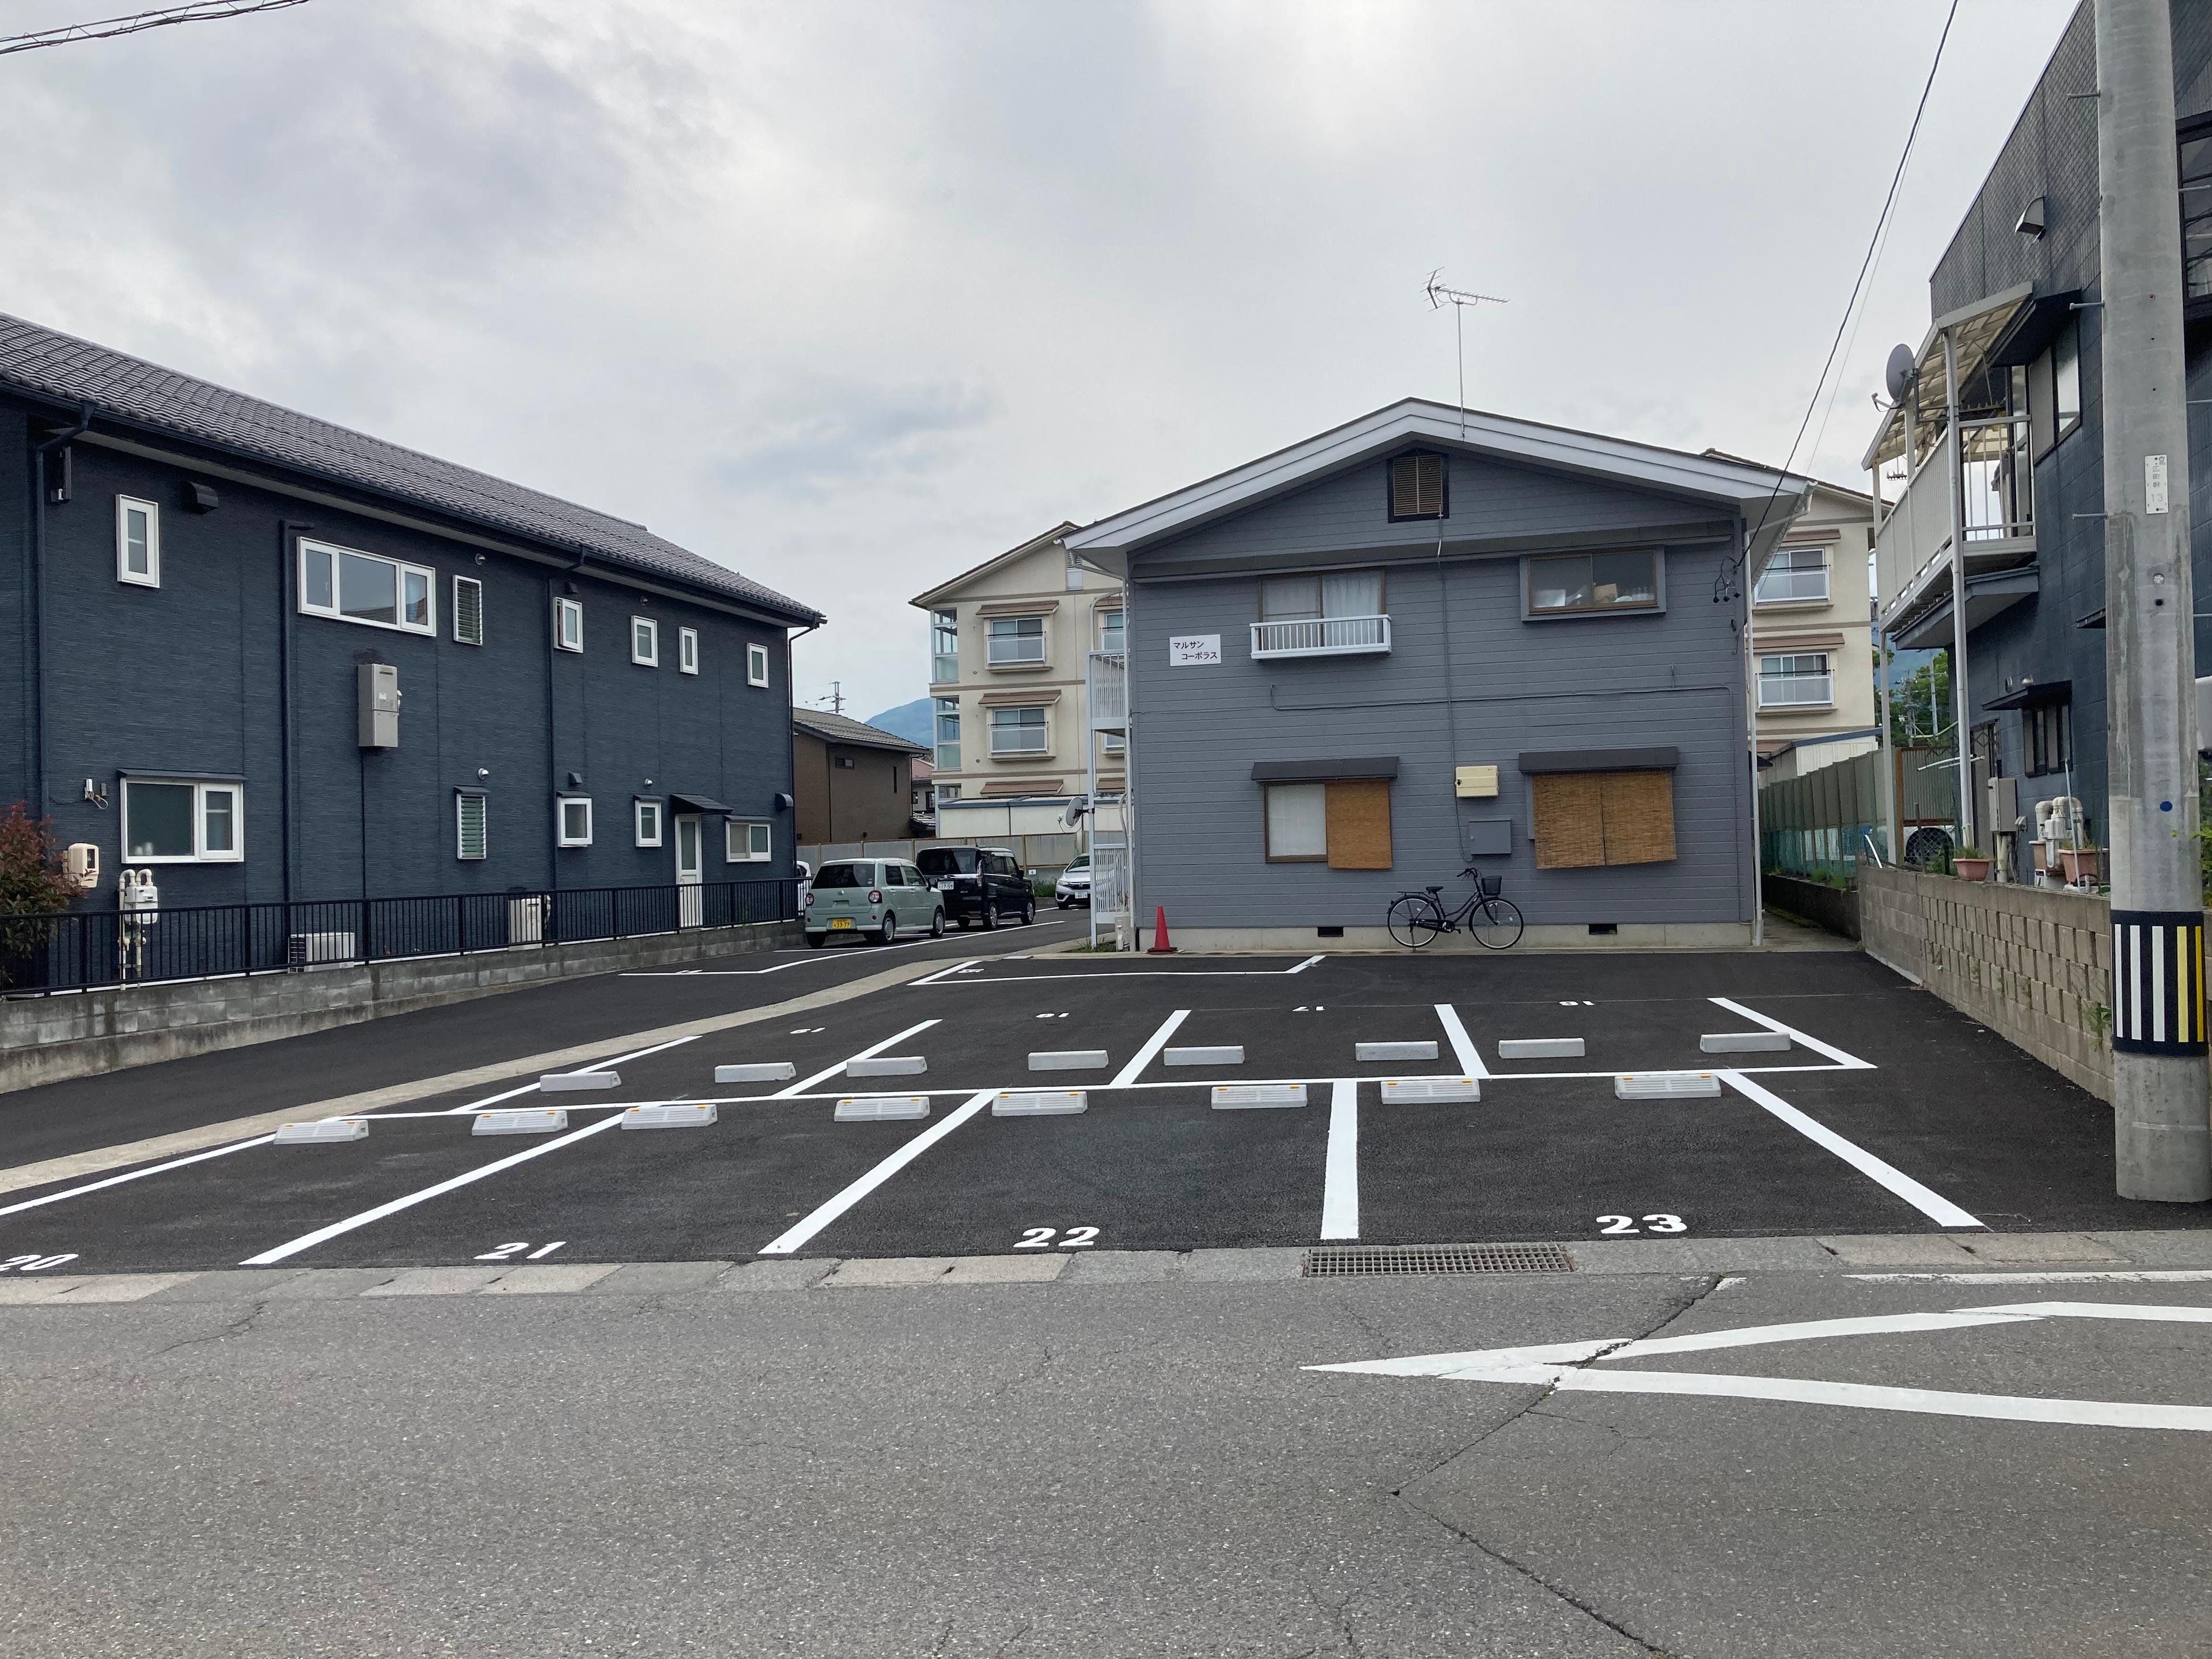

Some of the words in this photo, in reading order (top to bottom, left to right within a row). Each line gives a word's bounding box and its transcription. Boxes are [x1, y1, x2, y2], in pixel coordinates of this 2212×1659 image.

[2151, 494, 2163, 502] 13
[1173, 641, 1204, 649] マルサン
[1181, 652, 1218, 660] コーポラス
[1595, 1214, 1688, 1234] 23
[1013, 1226, 1100, 1248] 22
[474, 1241, 567, 1260] 21
